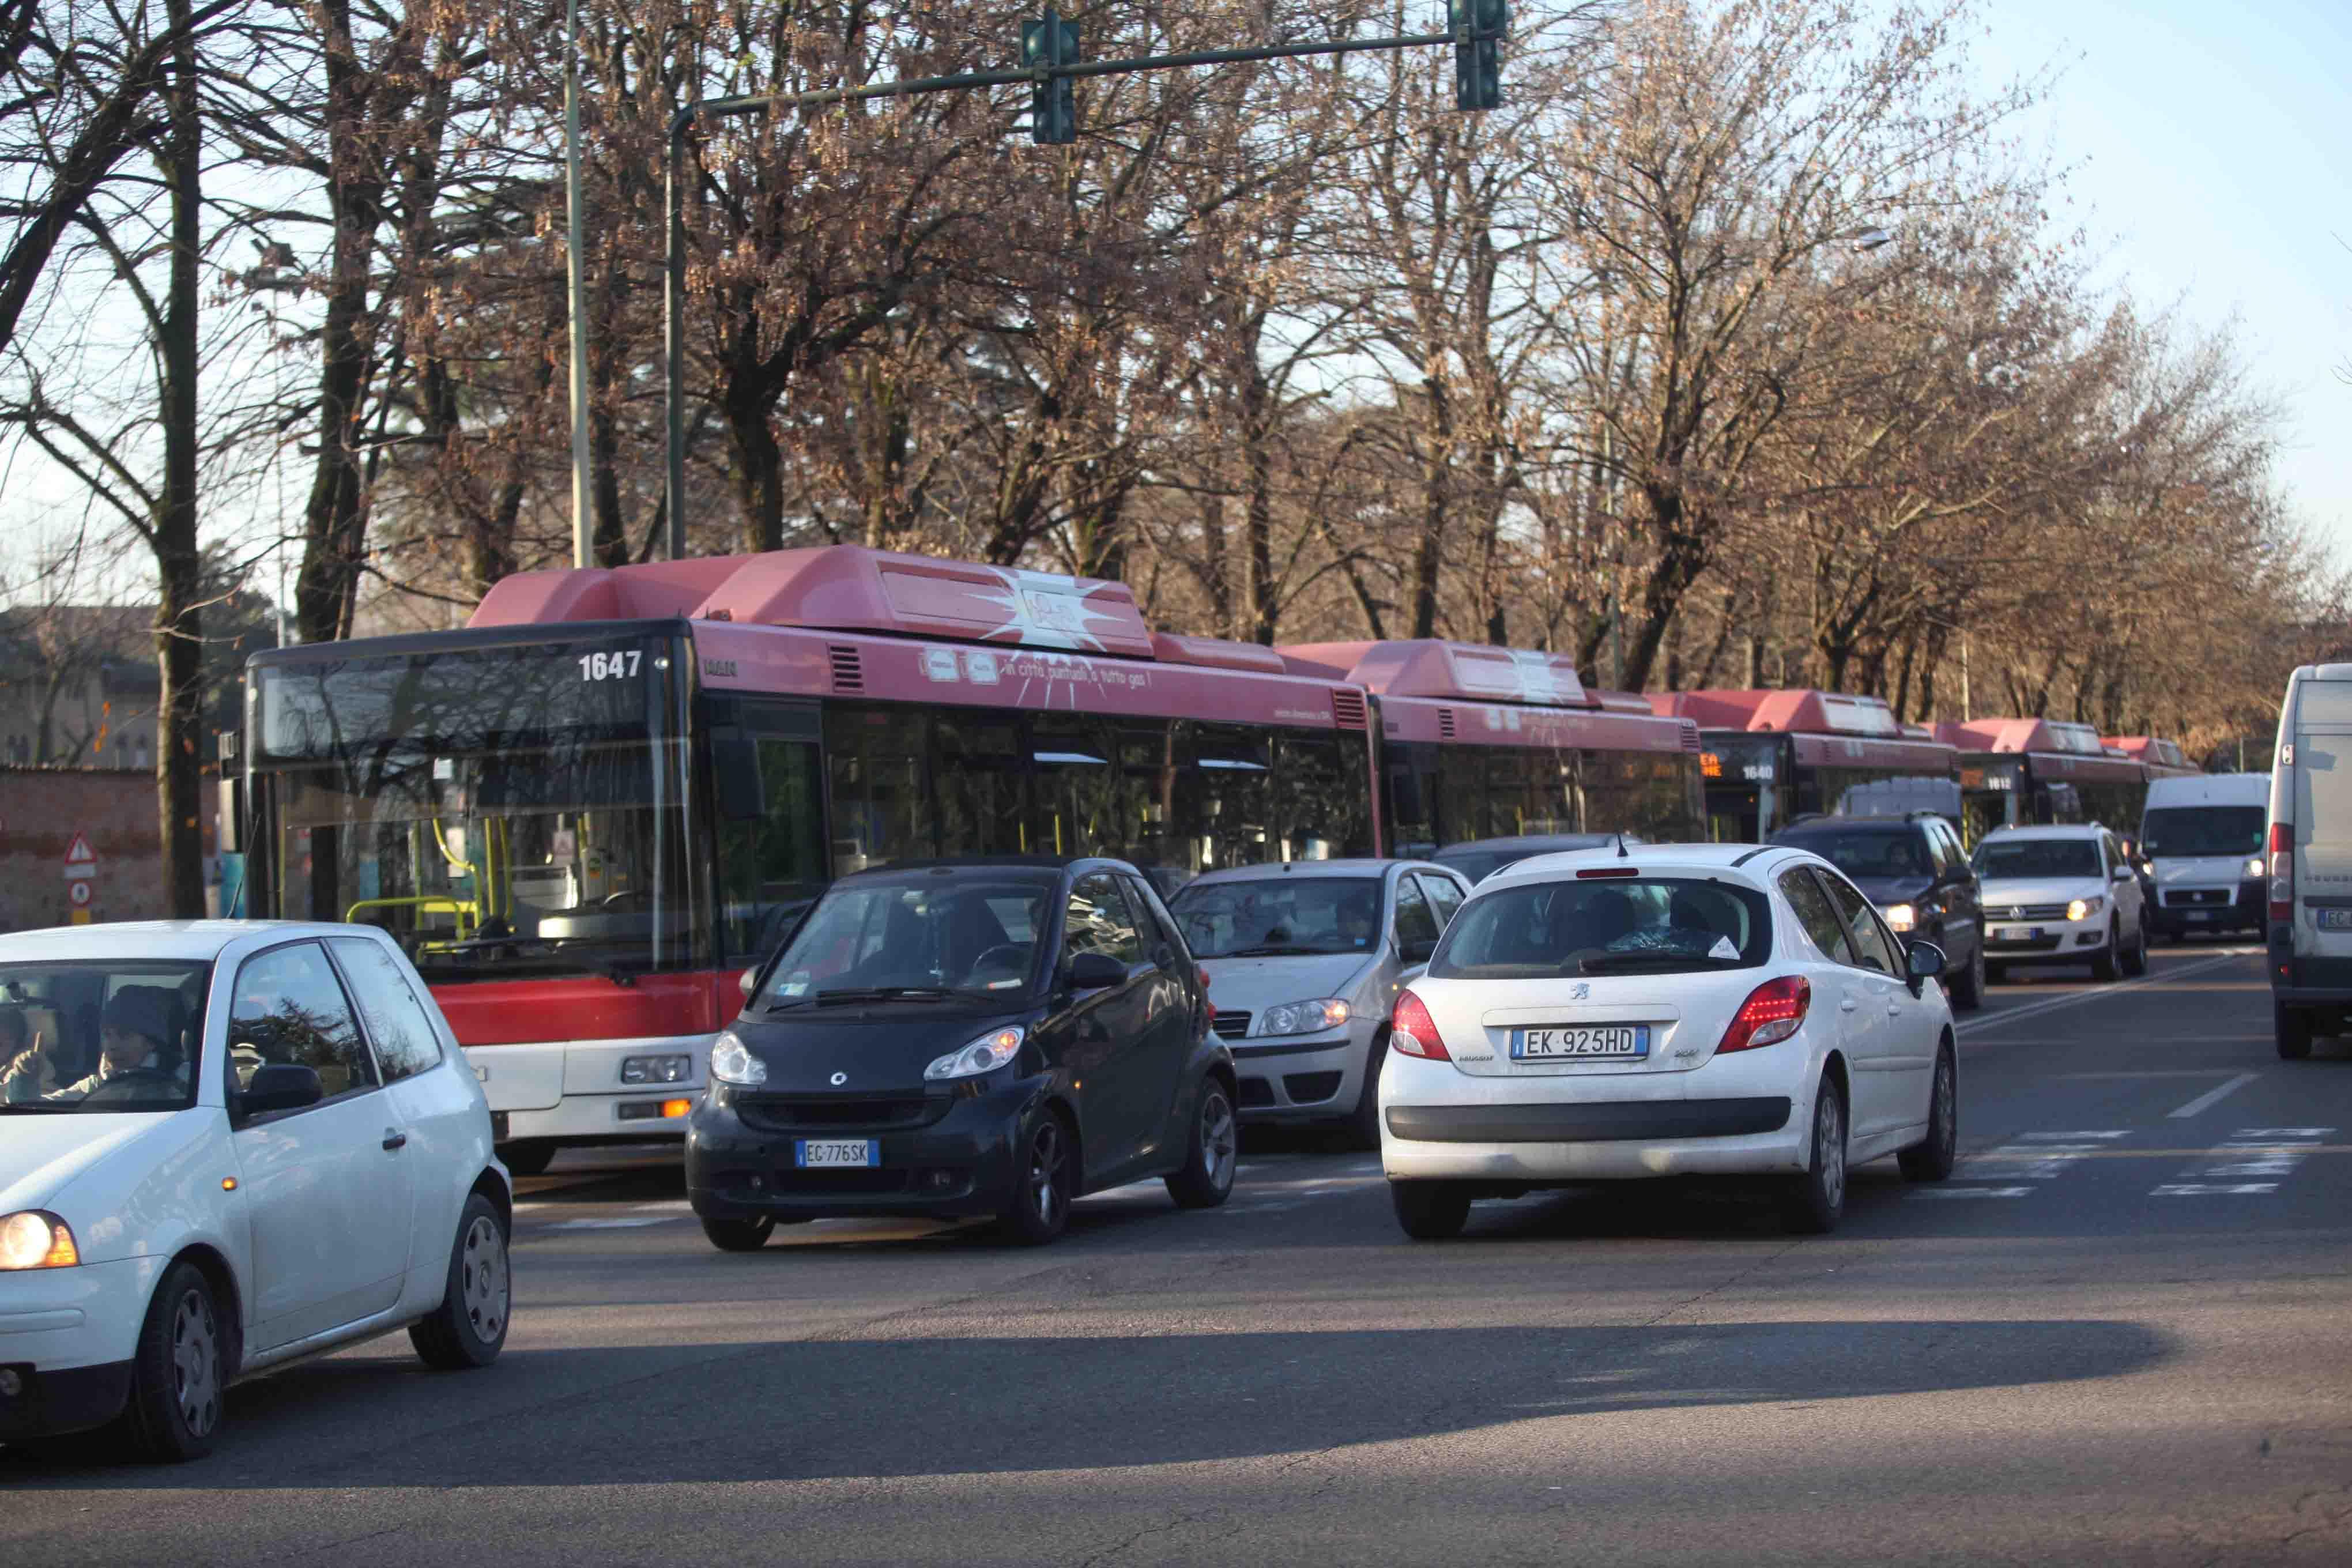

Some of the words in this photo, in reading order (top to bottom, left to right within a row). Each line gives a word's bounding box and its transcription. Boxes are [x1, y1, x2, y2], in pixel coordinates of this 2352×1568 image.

[578, 650, 642, 681] 1647
[1743, 766, 1773, 780] 1640
[1563, 1028, 1633, 1053] 925HD
